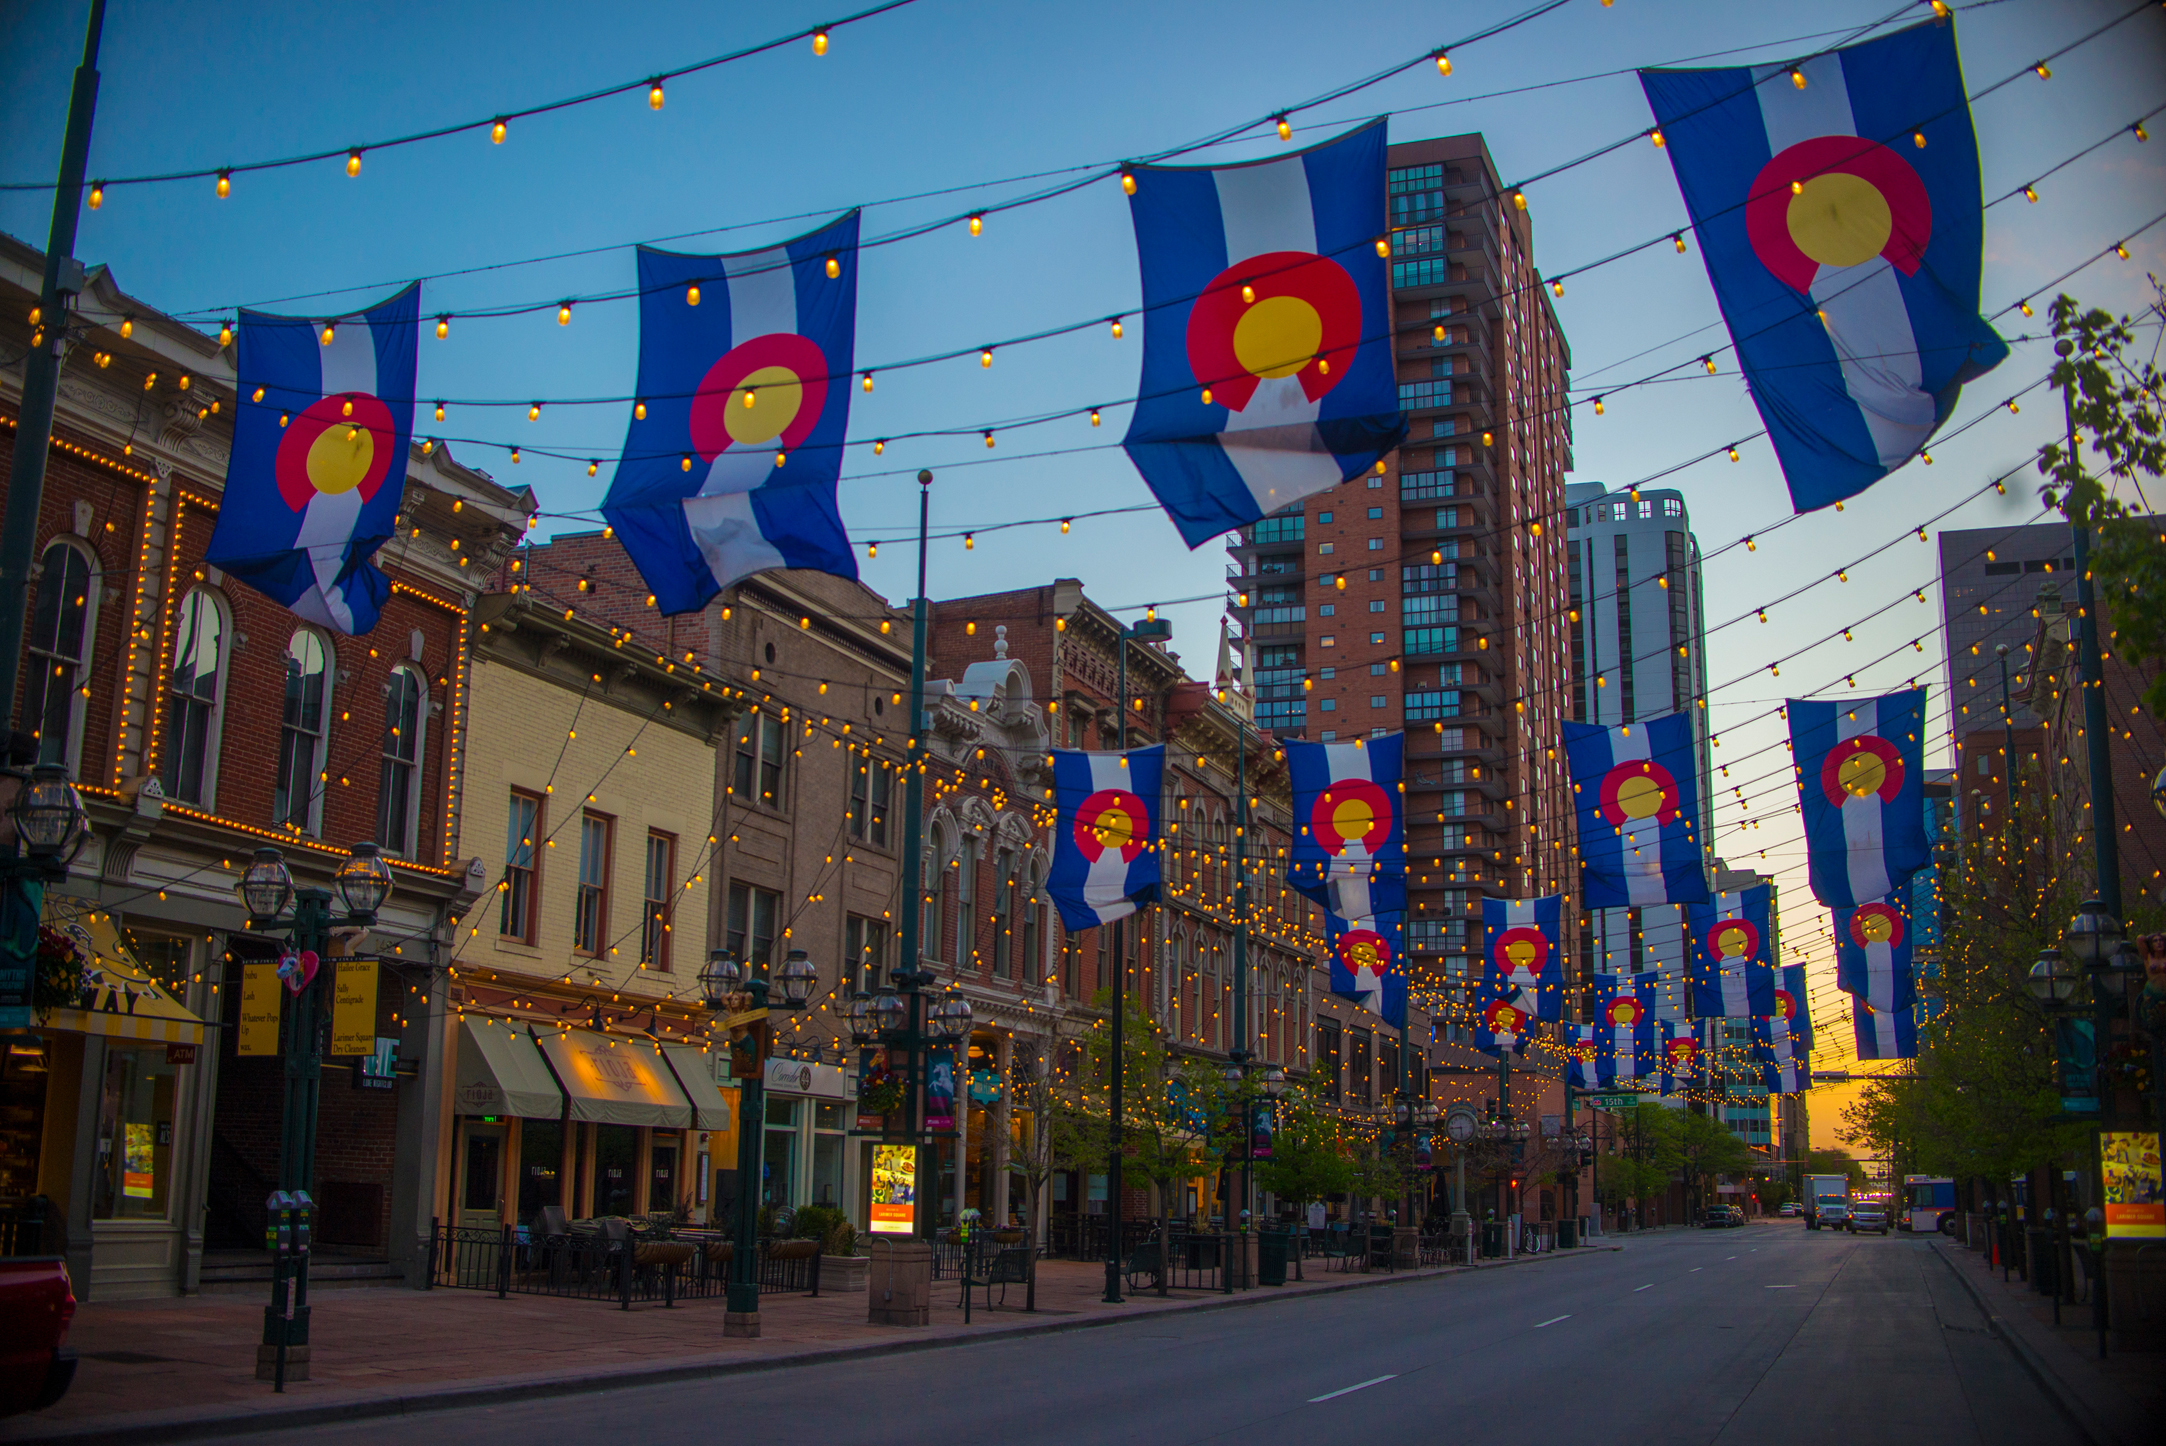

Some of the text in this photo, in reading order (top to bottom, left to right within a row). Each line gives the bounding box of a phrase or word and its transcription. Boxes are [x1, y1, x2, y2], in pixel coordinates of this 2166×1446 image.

[337, 962, 371, 972] Hailee Grace
[336, 984, 349, 994] Sally
[243, 991, 255, 1001] Lash
[335, 994, 364, 1005] Centigrade
[242, 1012, 278, 1024] Whatever Pops
[241, 1025, 250, 1035] Up
[333, 1032, 374, 1043] Larimer Square
[173, 1048, 194, 1060] ATM
[333, 1043, 367, 1055] Dry Cleaners
[1605, 1097, 1624, 1106] 15th
